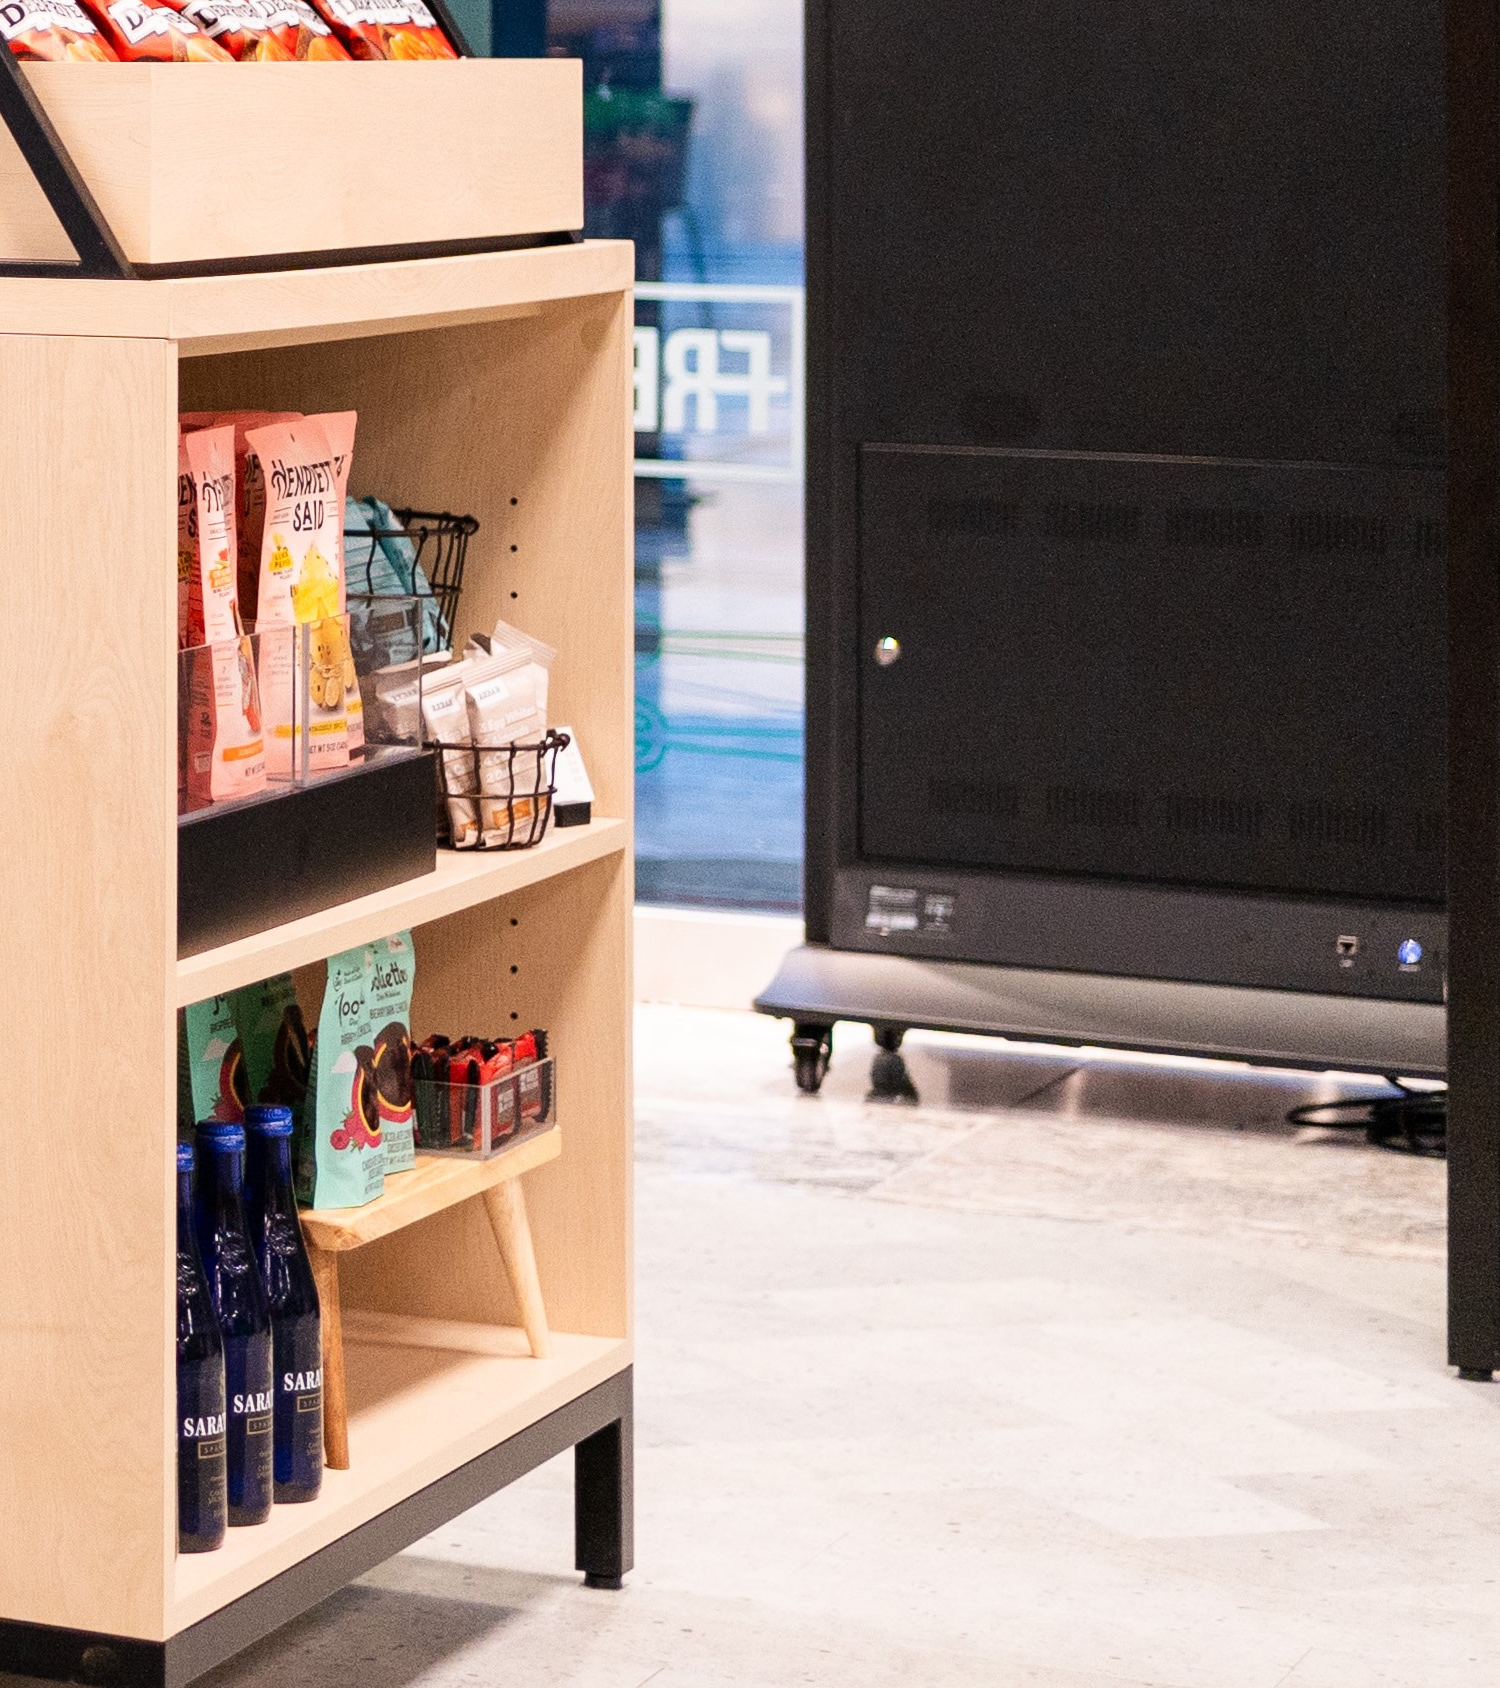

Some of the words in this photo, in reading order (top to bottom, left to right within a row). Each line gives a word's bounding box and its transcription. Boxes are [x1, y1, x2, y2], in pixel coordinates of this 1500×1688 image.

[270, 458, 333, 501] HENRIETT
[292, 499, 325, 532] SAID
[284, 1367, 323, 1392] SARA
[233, 1389, 274, 1414] SARA
[184, 1411, 227, 1438] SARA
